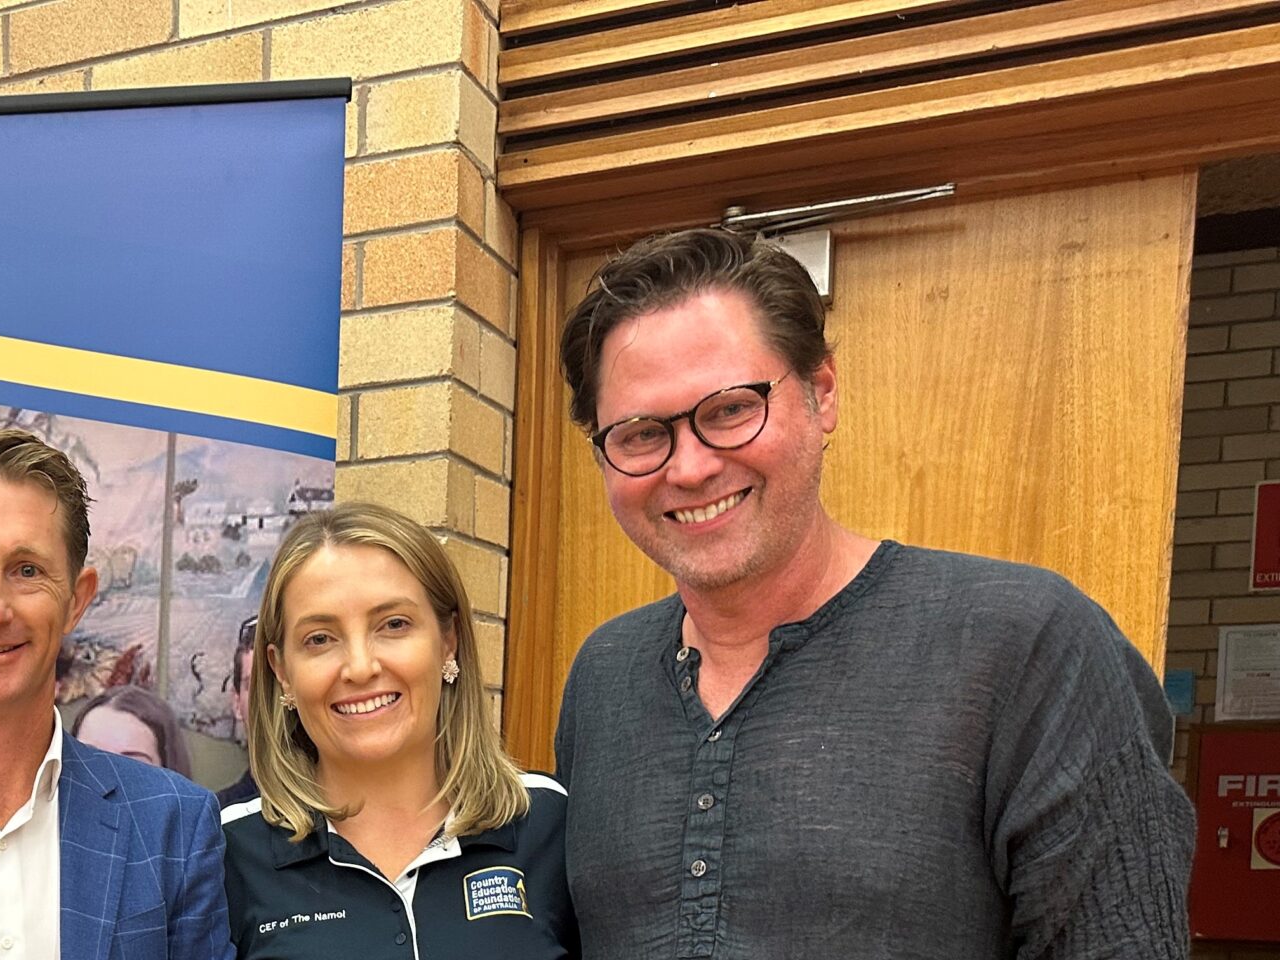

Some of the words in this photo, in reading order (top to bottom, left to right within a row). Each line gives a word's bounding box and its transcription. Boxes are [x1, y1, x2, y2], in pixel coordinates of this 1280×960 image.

[1256, 571, 1280, 583] EXTI
[471, 876, 508, 890] Country
[472, 884, 517, 899] Education
[259, 921, 278, 933] CEF
[279, 918, 289, 928] of
[291, 913, 311, 923] The
